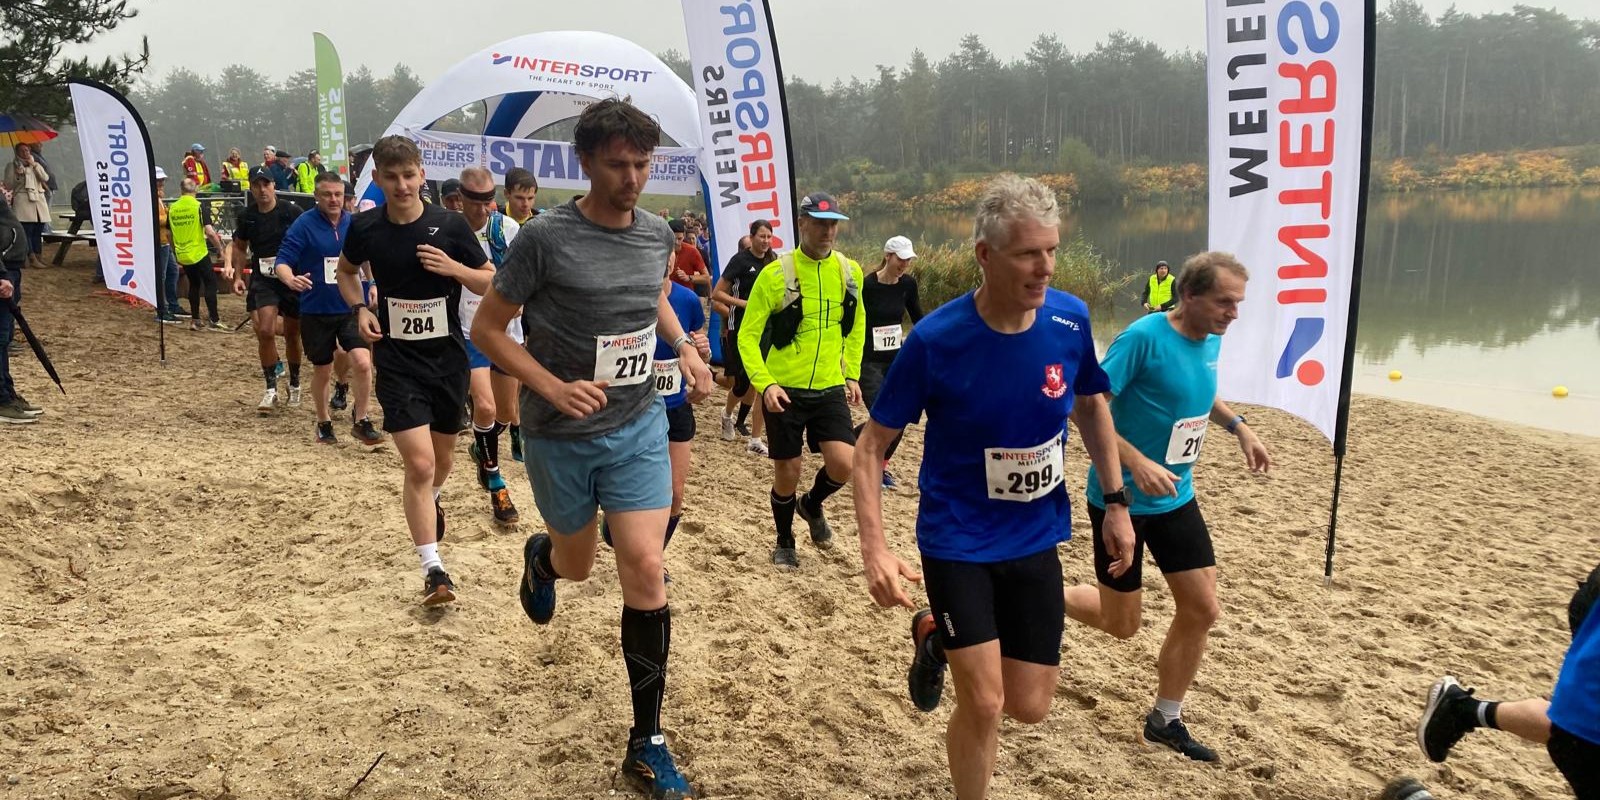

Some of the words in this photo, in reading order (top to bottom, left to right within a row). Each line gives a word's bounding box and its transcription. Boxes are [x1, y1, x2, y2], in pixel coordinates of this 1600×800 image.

[513, 56, 653, 83] INTERSPORT
[547, 77, 573, 85] HEART
[420, 140, 475, 151] INTERSPORT
[421, 149, 475, 162] EIJERS
[490, 140, 592, 181] STA
[652, 155, 696, 164] TERSPORT
[649, 163, 696, 175] EIJERS
[648, 174, 688, 182] UNSPEET
[397, 301, 442, 310] INTERSPORT
[402, 317, 435, 335] 284
[1051, 315, 1075, 329] CRAFT
[611, 330, 654, 347] INTERSPOR
[882, 336, 896, 347] 172
[615, 352, 648, 379] 272
[654, 375, 674, 391] 08
[1002, 442, 1057, 461] INTERSPO
[1018, 454, 1050, 466] MEIJERS
[1007, 463, 1053, 494] 299
